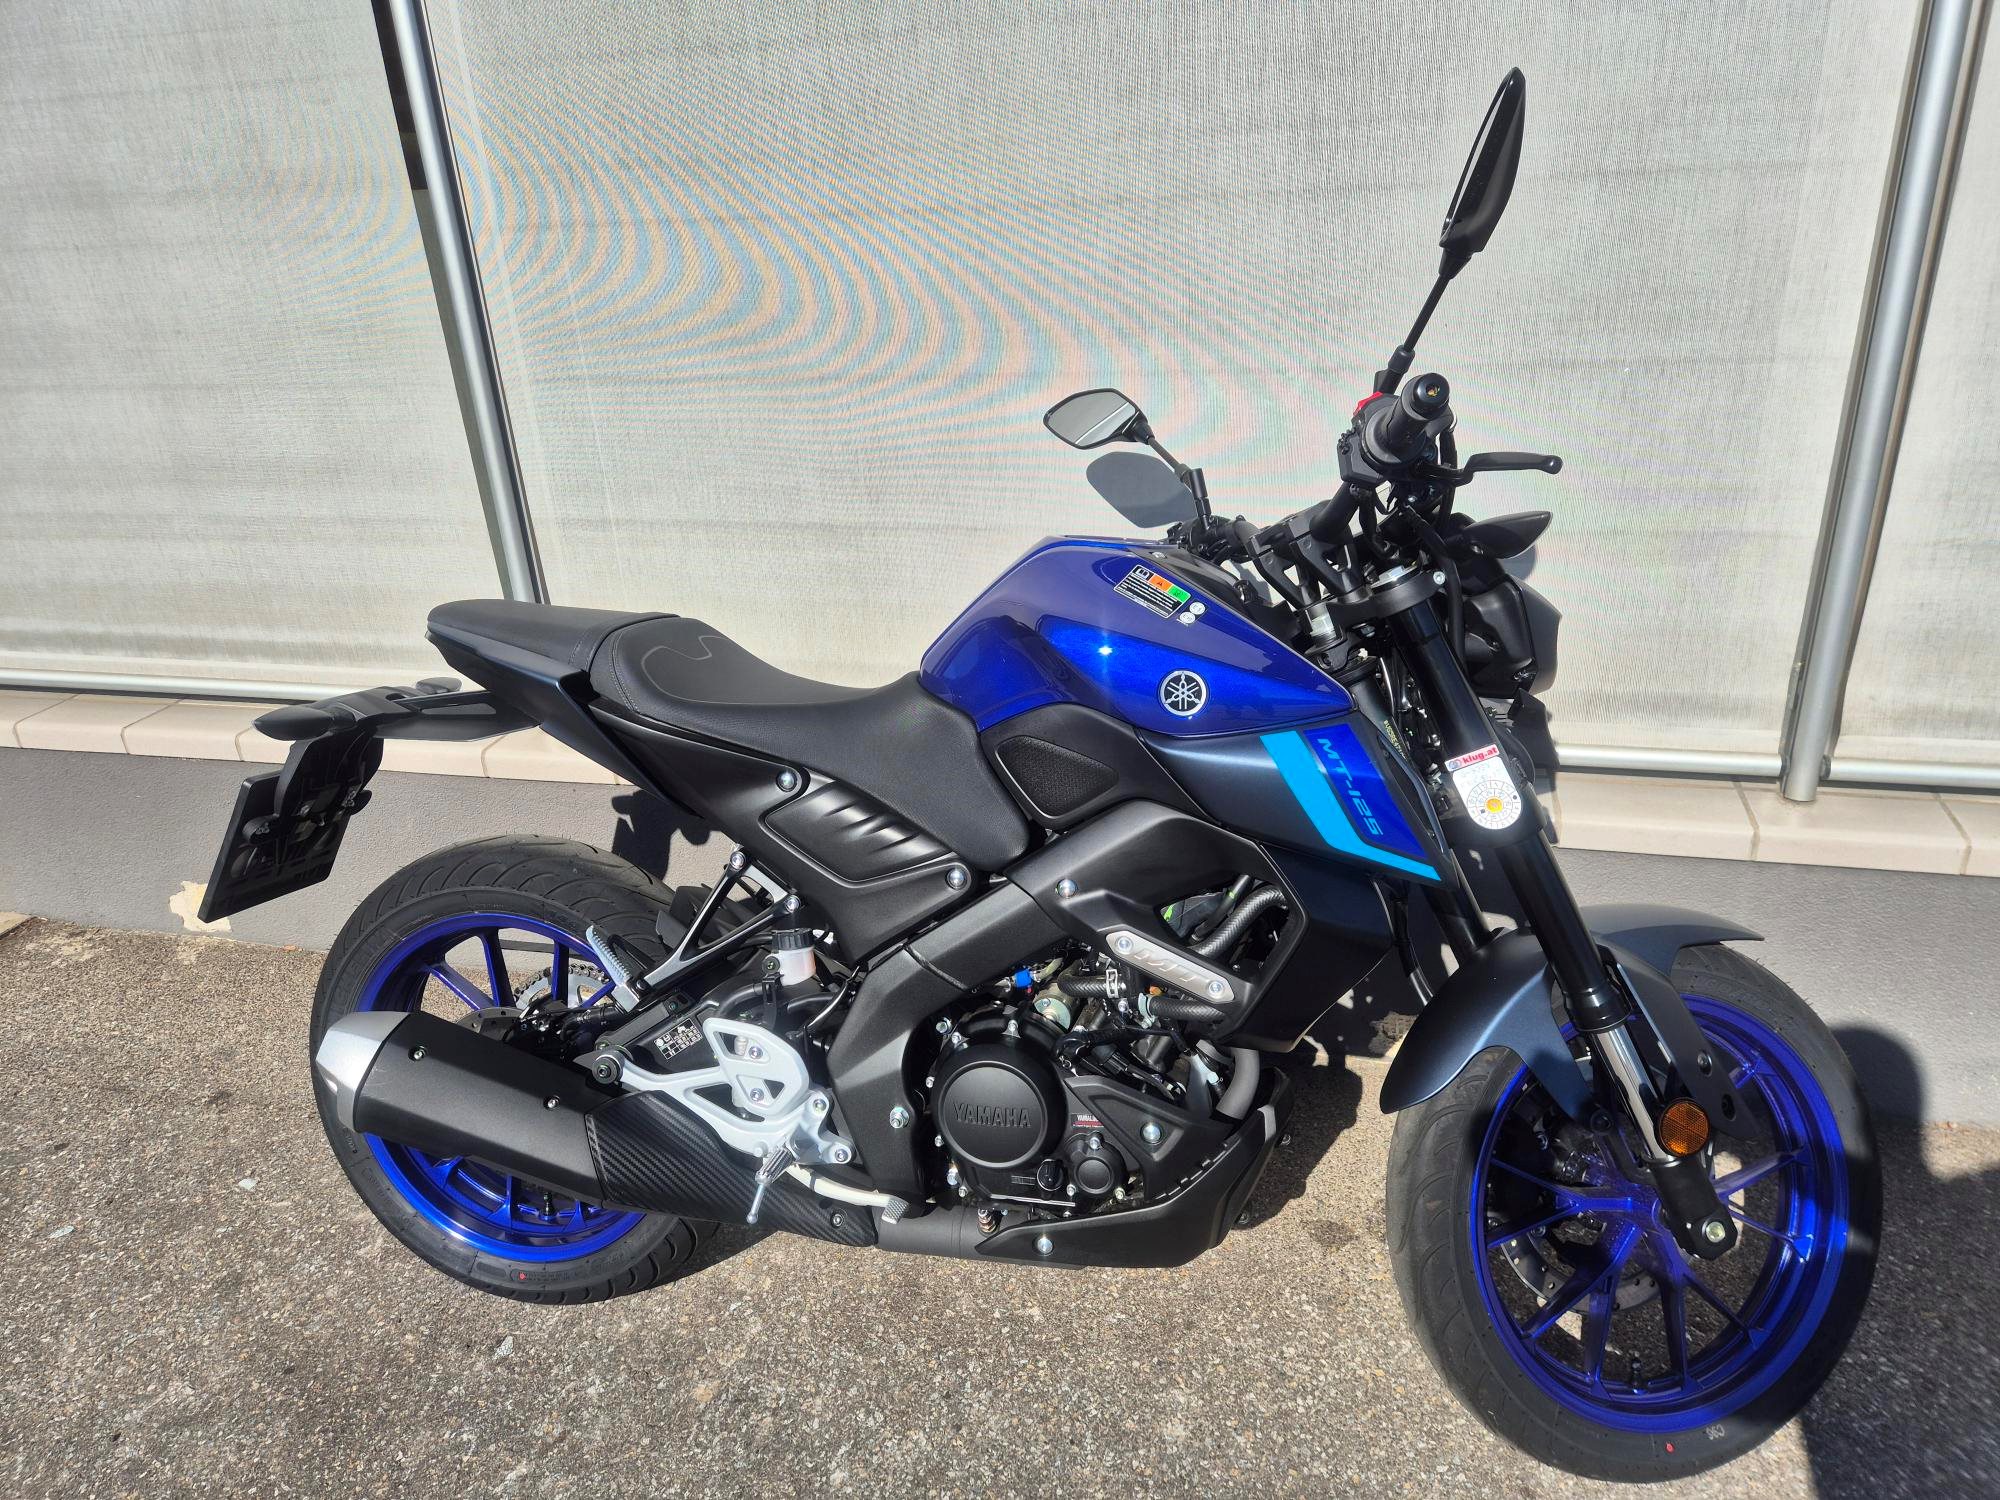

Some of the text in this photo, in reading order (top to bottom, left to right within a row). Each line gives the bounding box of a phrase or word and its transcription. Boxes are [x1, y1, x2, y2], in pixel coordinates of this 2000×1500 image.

[1462, 747, 1498, 764] klug.at
[1316, 738, 1384, 836] MT-125
[953, 1103, 1032, 1127] YAMAHA
